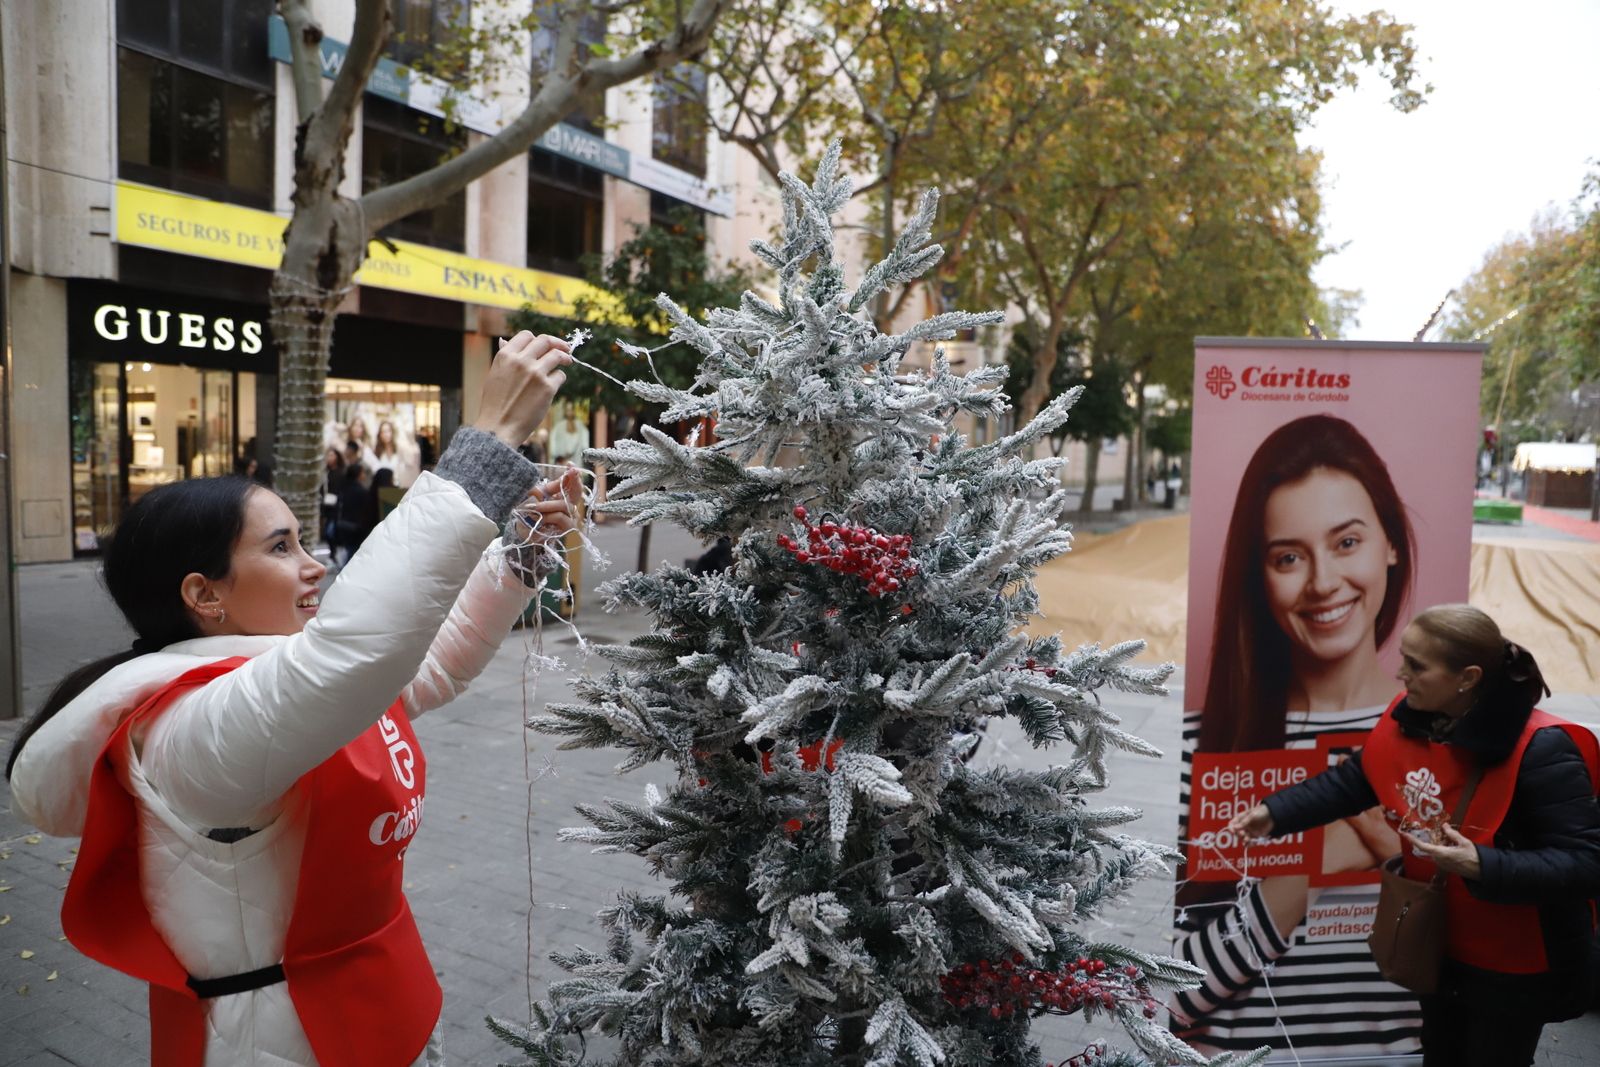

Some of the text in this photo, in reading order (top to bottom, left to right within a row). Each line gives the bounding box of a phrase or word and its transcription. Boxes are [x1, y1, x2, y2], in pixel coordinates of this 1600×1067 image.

[137, 212, 231, 244] SEGUROS
[237, 232, 261, 251] DE
[94, 304, 262, 354] GUESS
[1241, 365, 1350, 388] Cáritas
[1241, 391, 1349, 401] Diocesana de Córdoba
[1201, 765, 1307, 795] deja que
[1200, 793, 1262, 819] habl
[369, 794, 424, 846] Cárit
[1199, 853, 1303, 870] NADIE SIN HOGAR
[1309, 904, 1378, 920] ayuda/par
